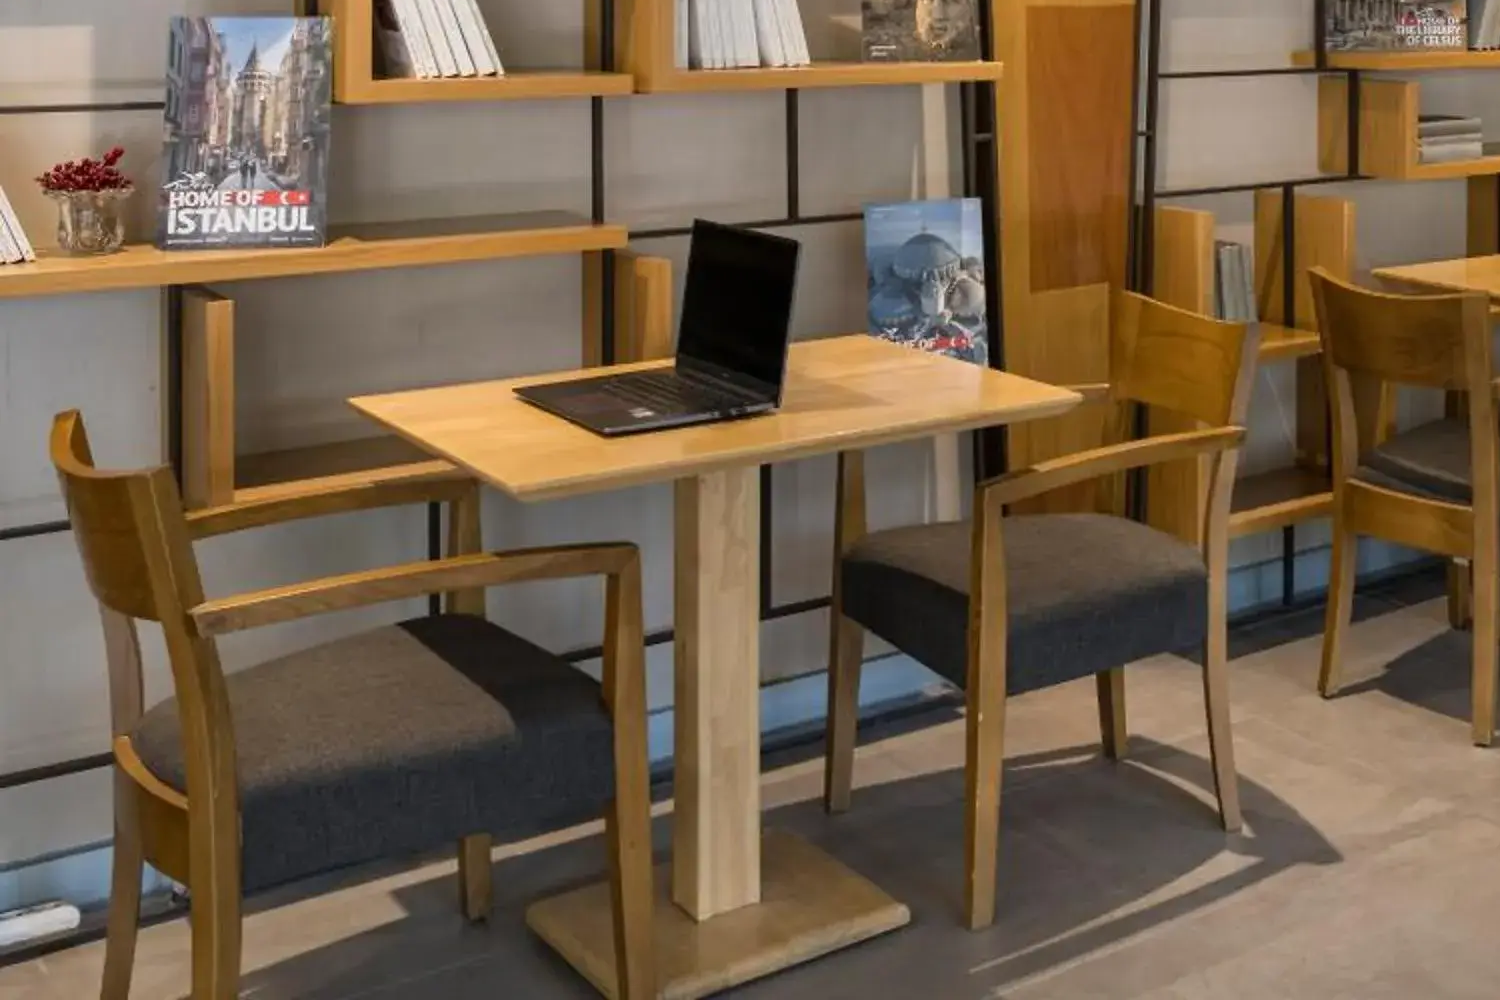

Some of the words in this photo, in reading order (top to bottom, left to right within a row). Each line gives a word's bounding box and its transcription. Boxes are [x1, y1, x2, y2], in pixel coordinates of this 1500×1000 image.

[169, 190, 233, 208] HOME
[235, 189, 265, 206] OF
[167, 206, 315, 235] ISTANBUL
